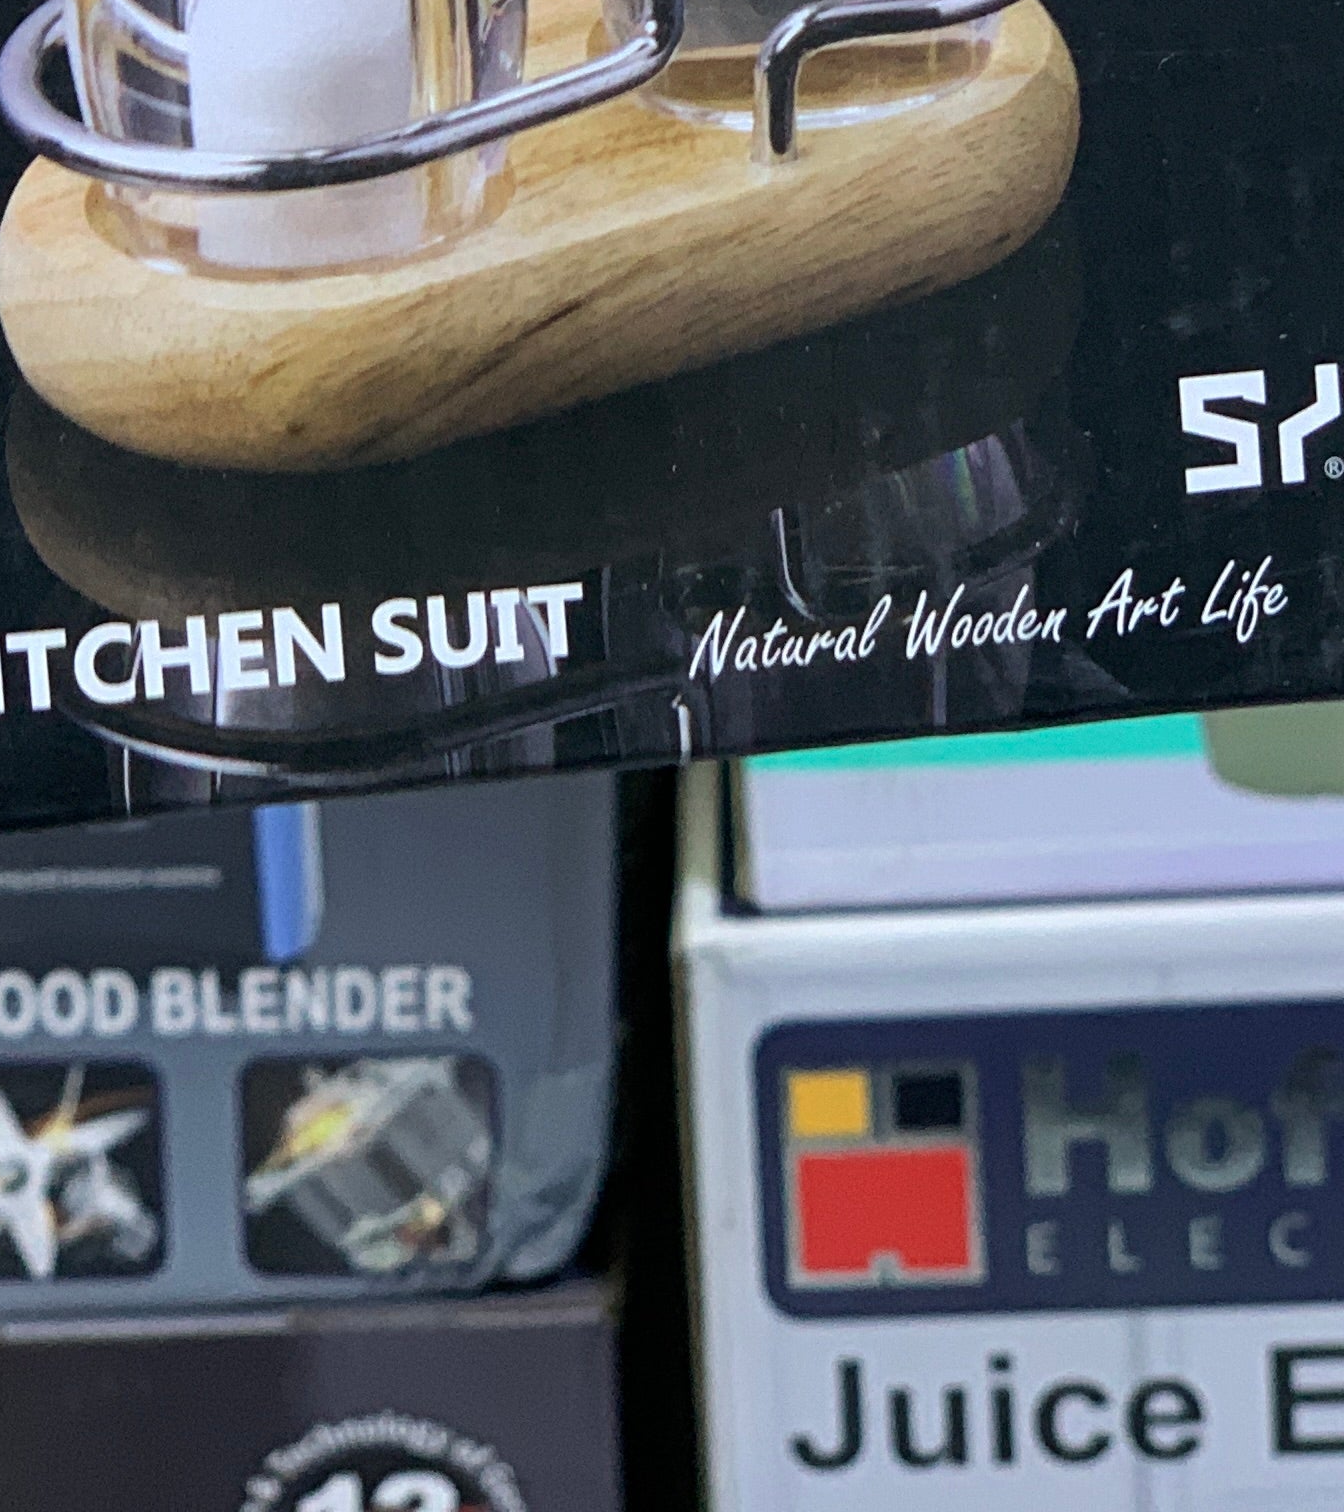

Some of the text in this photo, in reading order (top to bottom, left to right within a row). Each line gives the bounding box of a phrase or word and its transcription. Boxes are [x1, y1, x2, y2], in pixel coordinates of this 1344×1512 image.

[370, 582, 583, 677] SUIT
[688, 554, 1290, 679] Natural Wooden Art Life
[149, 962, 476, 1036] BLENDER
[789, 1352, 1208, 1472] Juice
